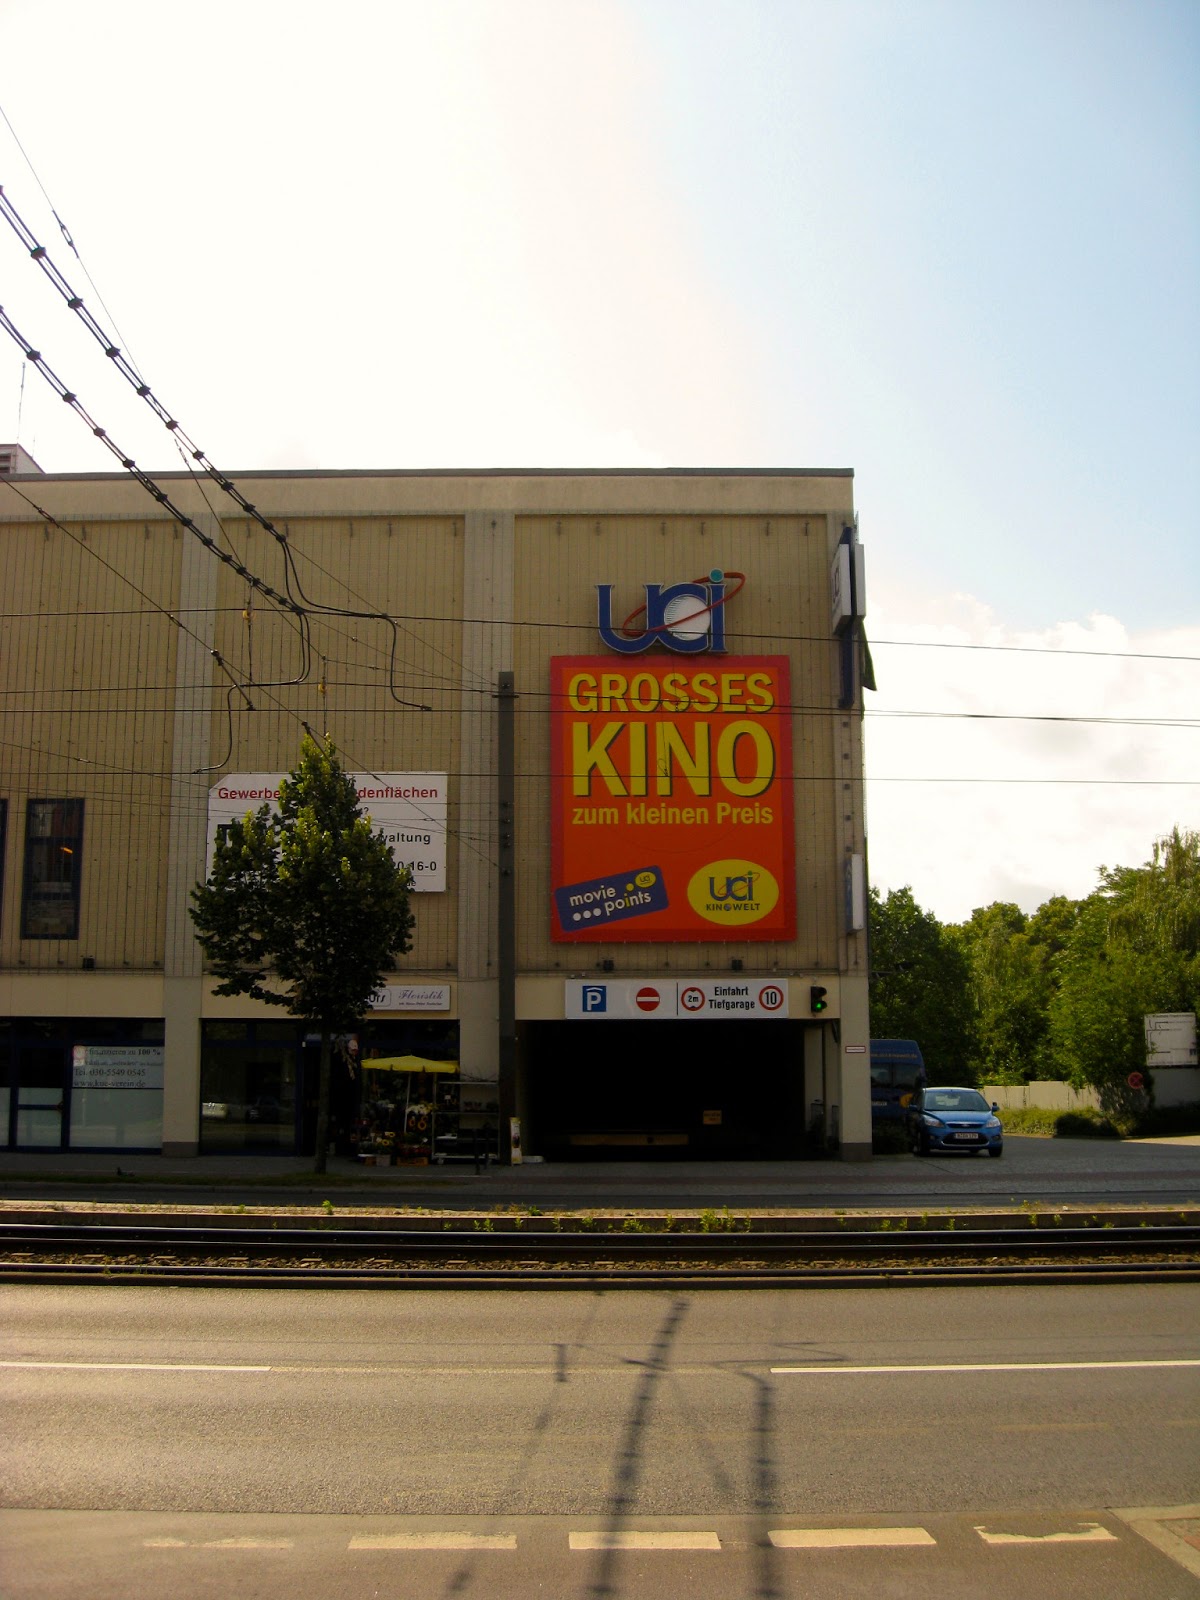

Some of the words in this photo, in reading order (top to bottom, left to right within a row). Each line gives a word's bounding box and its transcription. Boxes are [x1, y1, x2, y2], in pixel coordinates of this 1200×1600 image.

[567, 673, 775, 713] GROSSES
[572, 719, 776, 798] KINO
[356, 786, 438, 798] denflächen
[572, 807, 619, 825] zum
[626, 803, 709, 825] kleinen
[716, 803, 774, 825] Preis
[569, 884, 617, 907] movie
[604, 891, 652, 917] points
[586, 991, 602, 1011] P
[714, 986, 749, 997] Einfahrt
[764, 991, 777, 1006] 10
[708, 999, 755, 1010] Tiefgarage
